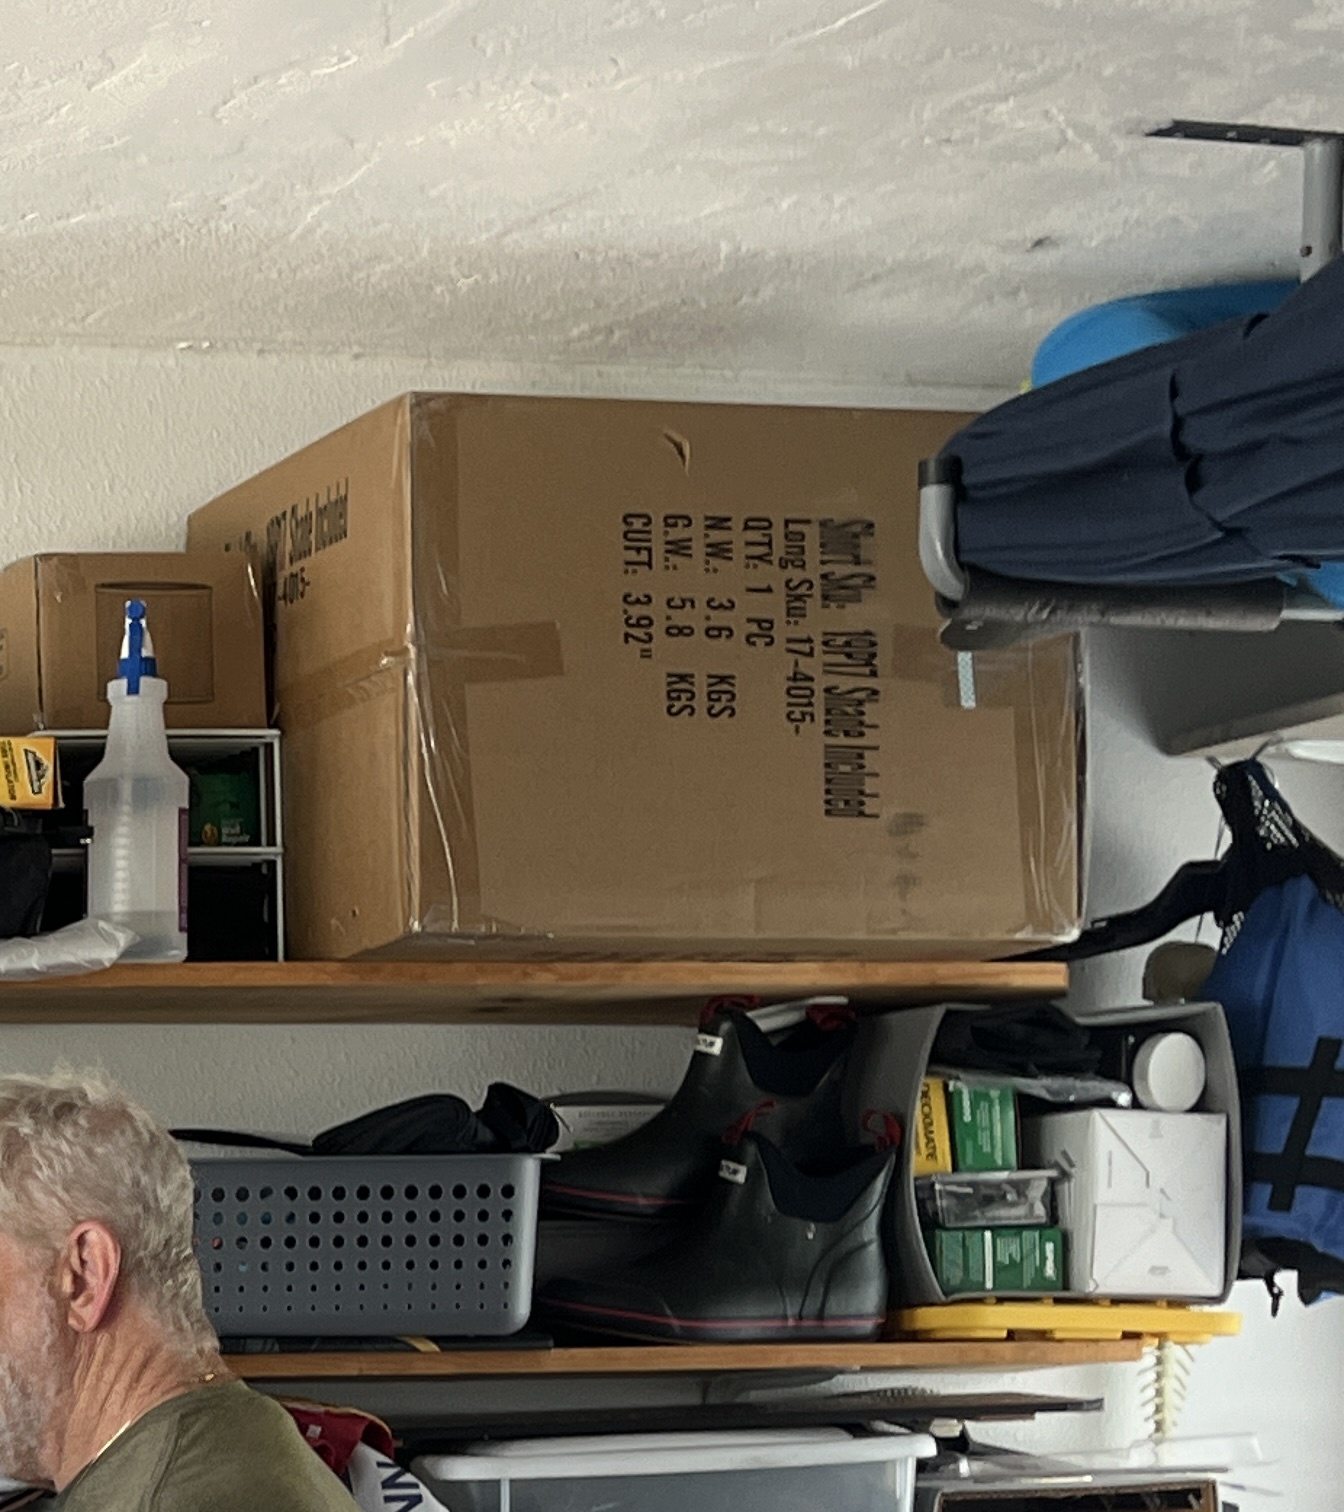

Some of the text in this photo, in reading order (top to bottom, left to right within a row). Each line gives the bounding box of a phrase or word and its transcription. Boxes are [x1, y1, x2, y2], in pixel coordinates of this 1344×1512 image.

[622, 512, 653, 575] CUFT:
[742, 516, 775, 648] QTY: 1 PC
[665, 596, 695, 638] 5.8
[705, 597, 735, 640] 3.6
[778, 518, 815, 736] Long Sku: 17-4015-
[666, 672, 696, 718] KGS
[707, 673, 736, 719] KGS
